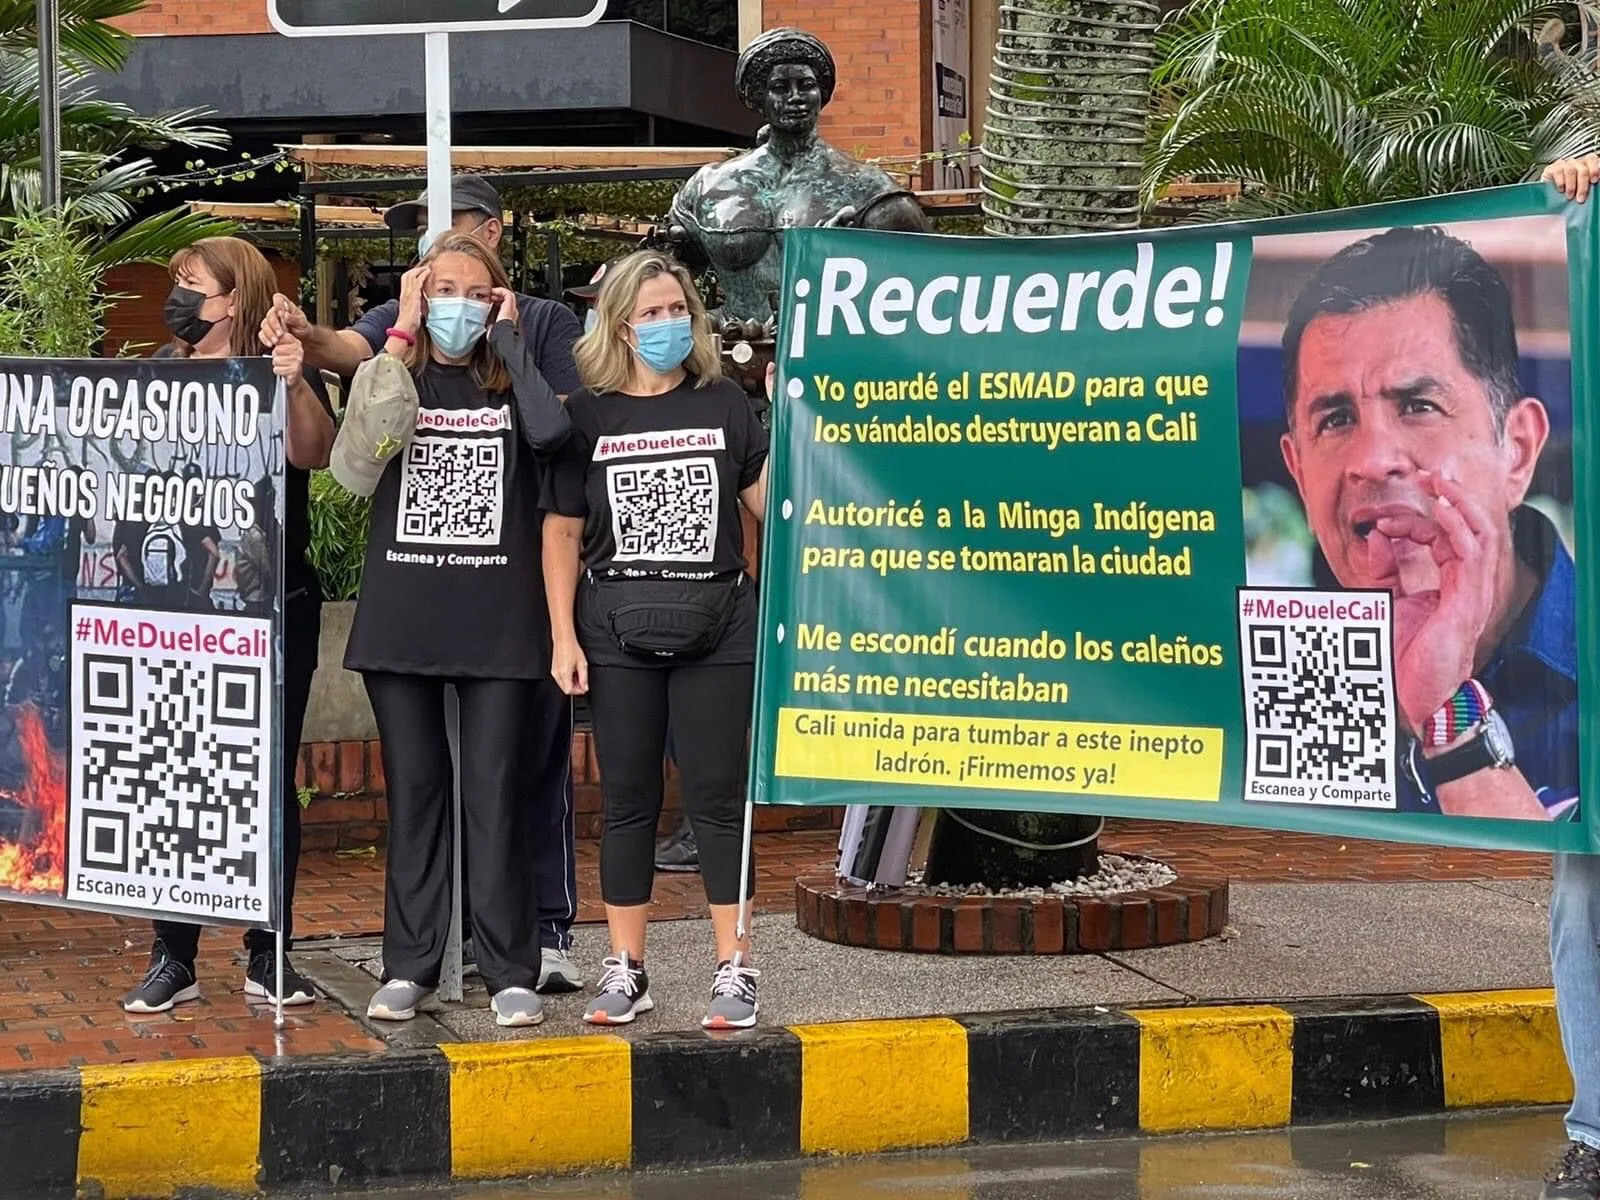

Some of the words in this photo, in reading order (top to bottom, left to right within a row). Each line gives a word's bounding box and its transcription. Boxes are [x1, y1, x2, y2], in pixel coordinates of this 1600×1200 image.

[789, 242, 1233, 358] ¡Recuerde!
[813, 375, 845, 401] Yo
[854, 372, 938, 408] guardé
[947, 371, 969, 400] el
[979, 371, 1076, 400] ESMAD
[1085, 375, 1144, 406] para
[1155, 374, 1208, 405] que
[68, 376, 260, 446] OCASIONO
[600, 433, 717, 455] #MeDueleCali
[814, 415, 851, 443] los
[855, 415, 962, 443] vándalos
[966, 414, 1120, 450] destruyeran
[1126, 420, 1141, 441] a
[1146, 412, 1197, 441] Cali
[105, 472, 256, 529] NEGOCIOS
[804, 499, 924, 527] Autoricé
[937, 507, 951, 528] a
[963, 499, 985, 528] la
[998, 501, 1080, 537] Minga
[1093, 501, 1215, 539] Indígena
[386, 549, 434, 563] Escanea
[436, 555, 445, 567] y
[447, 553, 508, 568] Comparte
[802, 546, 864, 574] para
[870, 549, 922, 576] que
[927, 550, 956, 570] se
[960, 545, 1068, 573] tomaran
[1072, 544, 1096, 574] la
[1101, 545, 1191, 576] ciudad
[1242, 599, 1385, 620] #MeDueleCali
[76, 617, 266, 657] #MeDueleCali
[797, 623, 842, 651] Me
[850, 627, 957, 656] escondí
[964, 630, 1066, 660] cuando
[1075, 631, 1114, 661] los
[1121, 634, 1223, 666] caleños
[793, 665, 851, 693] más
[856, 674, 899, 696] me
[904, 671, 1068, 703] necesitaban
[795, 714, 836, 736] Cali
[844, 717, 904, 740] unida
[912, 725, 960, 746] para
[968, 723, 1050, 747] tumbar
[1056, 731, 1068, 748] a
[1076, 730, 1122, 751] este
[1129, 729, 1204, 759] inepto
[875, 750, 951, 775] ladrón.
[959, 755, 1076, 782] ¡Firmemos
[1081, 763, 1117, 789] ya!
[1251, 780, 1305, 797] Escanea
[1309, 787, 1318, 801] y
[1322, 785, 1391, 803] Comparte
[76, 874, 146, 898] Escanea
[153, 885, 163, 904] y
[169, 885, 262, 912] Comparte
